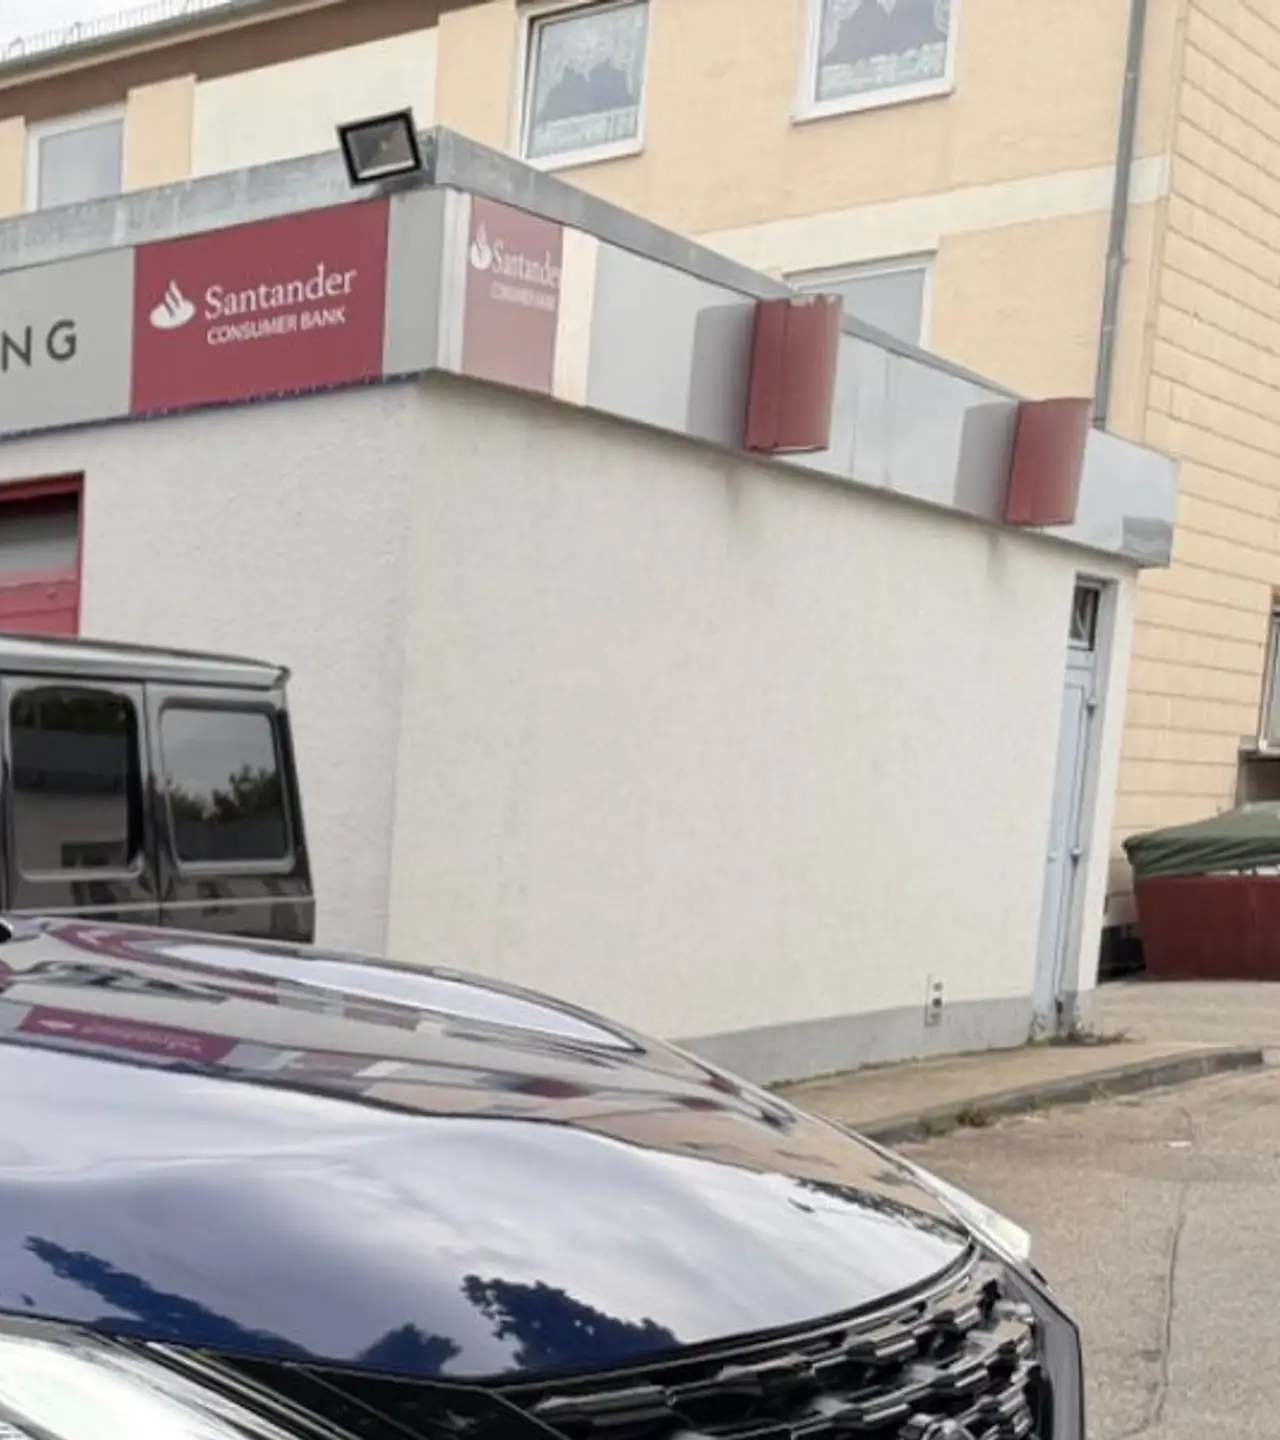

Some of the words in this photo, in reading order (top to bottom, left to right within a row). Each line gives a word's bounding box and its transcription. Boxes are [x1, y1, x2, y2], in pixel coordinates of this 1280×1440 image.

[203, 261, 358, 321] Santander
[206, 312, 299, 346] CONSUMER
[300, 304, 347, 328] BANK
